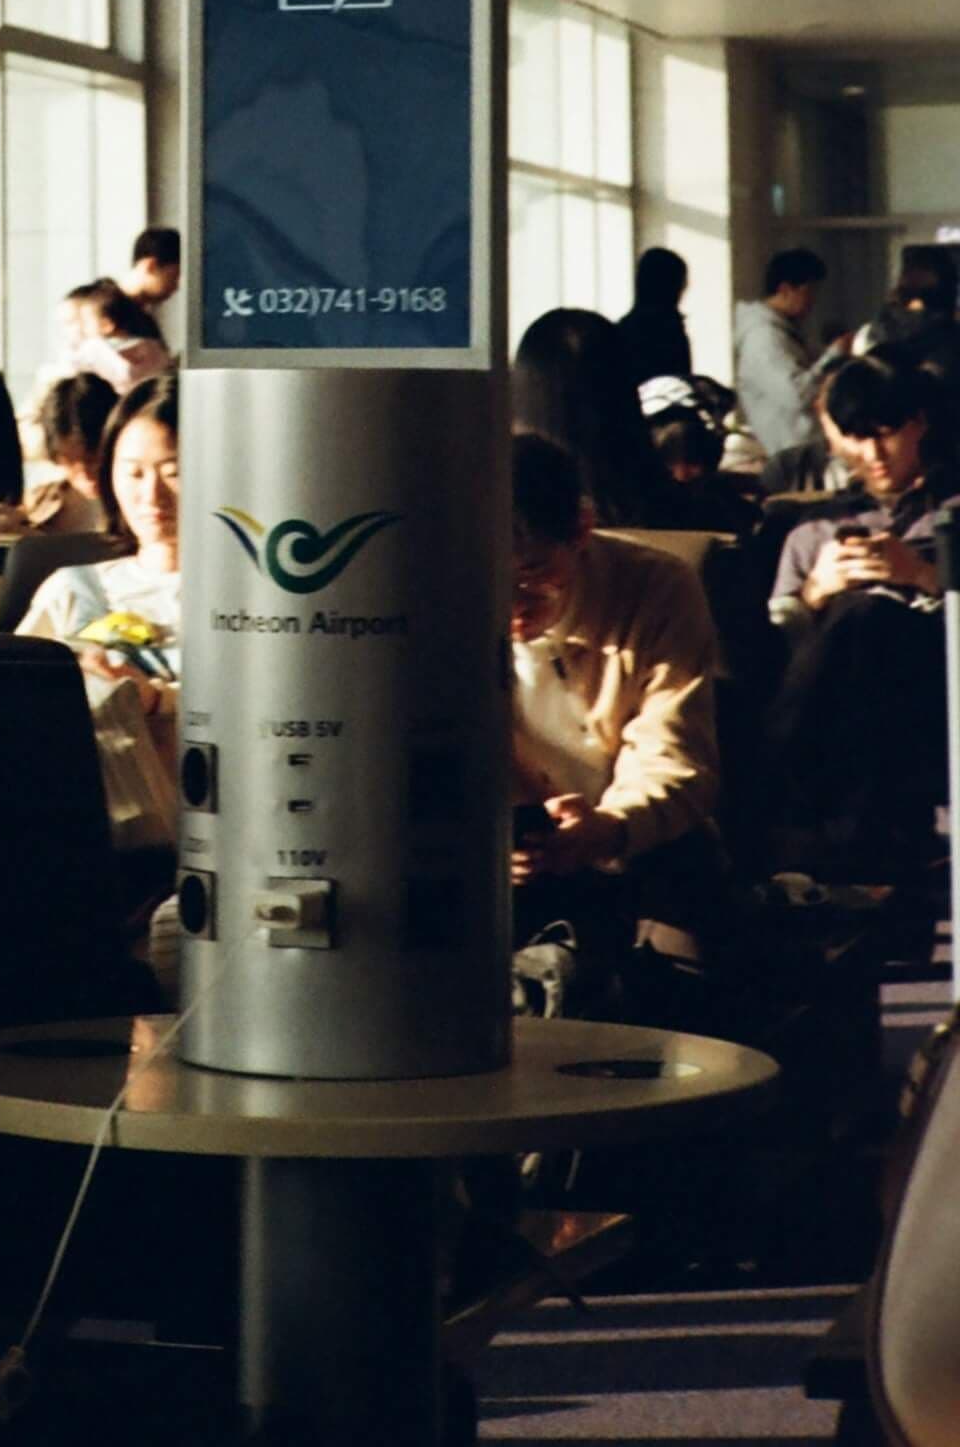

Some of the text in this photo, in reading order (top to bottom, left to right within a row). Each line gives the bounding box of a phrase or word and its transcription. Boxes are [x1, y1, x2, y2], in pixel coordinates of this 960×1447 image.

[258, 285, 448, 318] 032)741-9168
[212, 609, 409, 640] Incheon Airport
[271, 720, 343, 737] USB 5V
[276, 849, 328, 867] 110V
